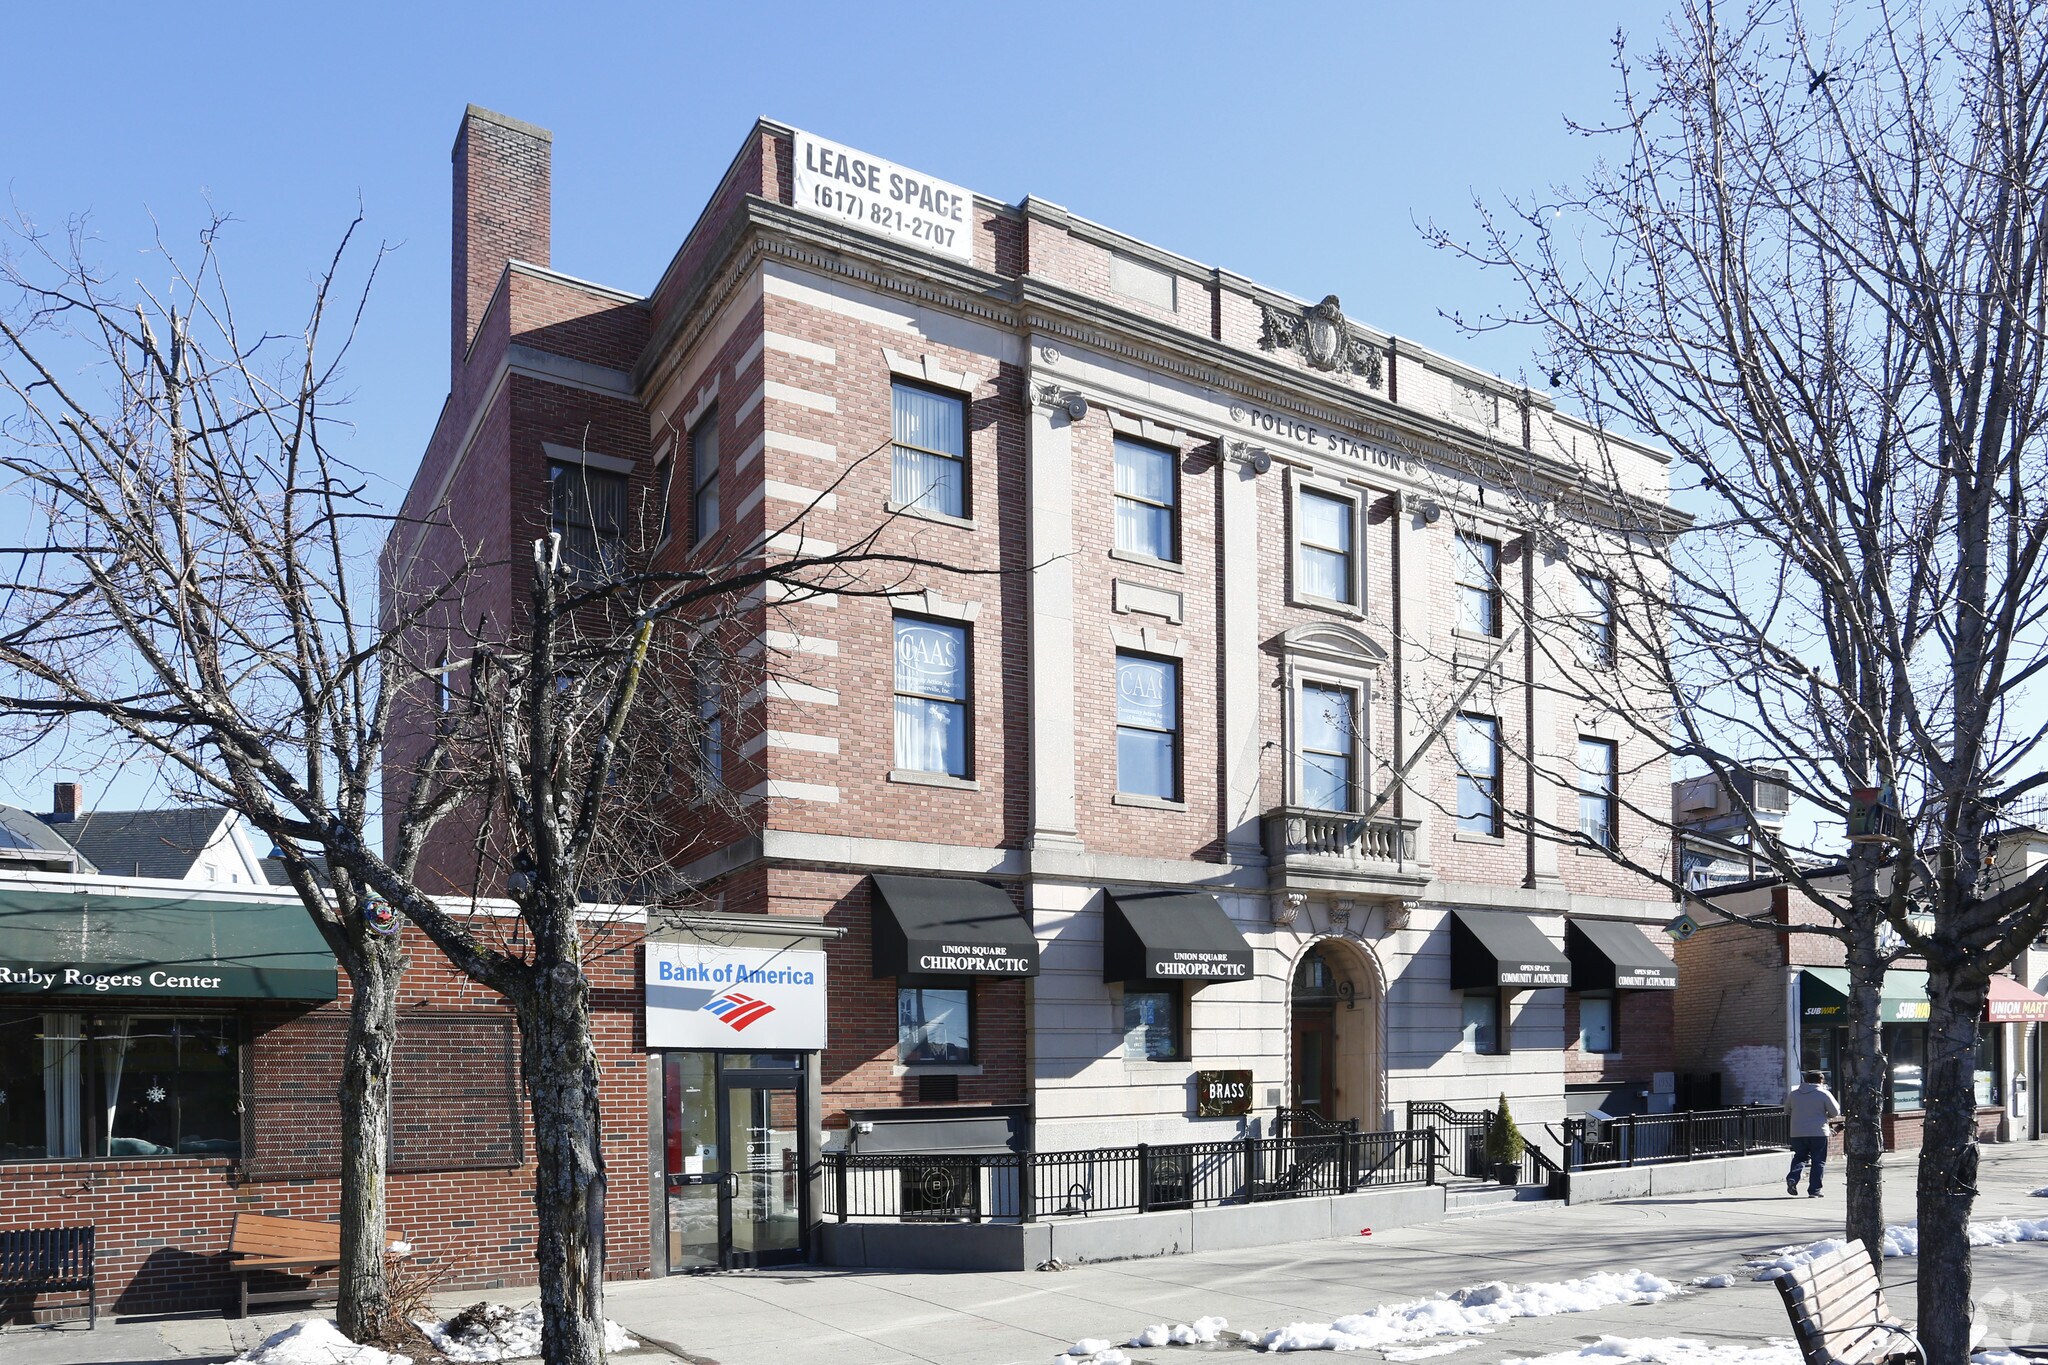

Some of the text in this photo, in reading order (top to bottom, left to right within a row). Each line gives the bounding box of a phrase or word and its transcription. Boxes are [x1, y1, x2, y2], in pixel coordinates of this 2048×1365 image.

[806, 142, 963, 223] LEASE SPACE
[814, 183, 955, 248] (617) 821-2707
[1250, 409, 1401, 471] POLICE STATION
[901, 633, 957, 668] CAAS
[942, 945, 1007, 957] UNION SQUARE
[1173, 952, 1228, 962] UNION SQUARE
[920, 955, 1029, 972] CHIROPRACTIC
[1155, 962, 1246, 976] CHIROPRACTIC
[1520, 964, 1550, 972] OPEN SPACE
[0, 967, 222, 991] Ruby Rogers Center
[659, 961, 814, 985] Bank of America
[1501, 972, 1569, 984] COMMUNITY ACUPUNCTURE
[1804, 1006, 1841, 1015] SUBWAY
[1895, 1001, 1931, 1019] SUBWA
[1991, 1001, 2048, 1014] UNION MART
[1209, 1082, 1245, 1099] BRASS
